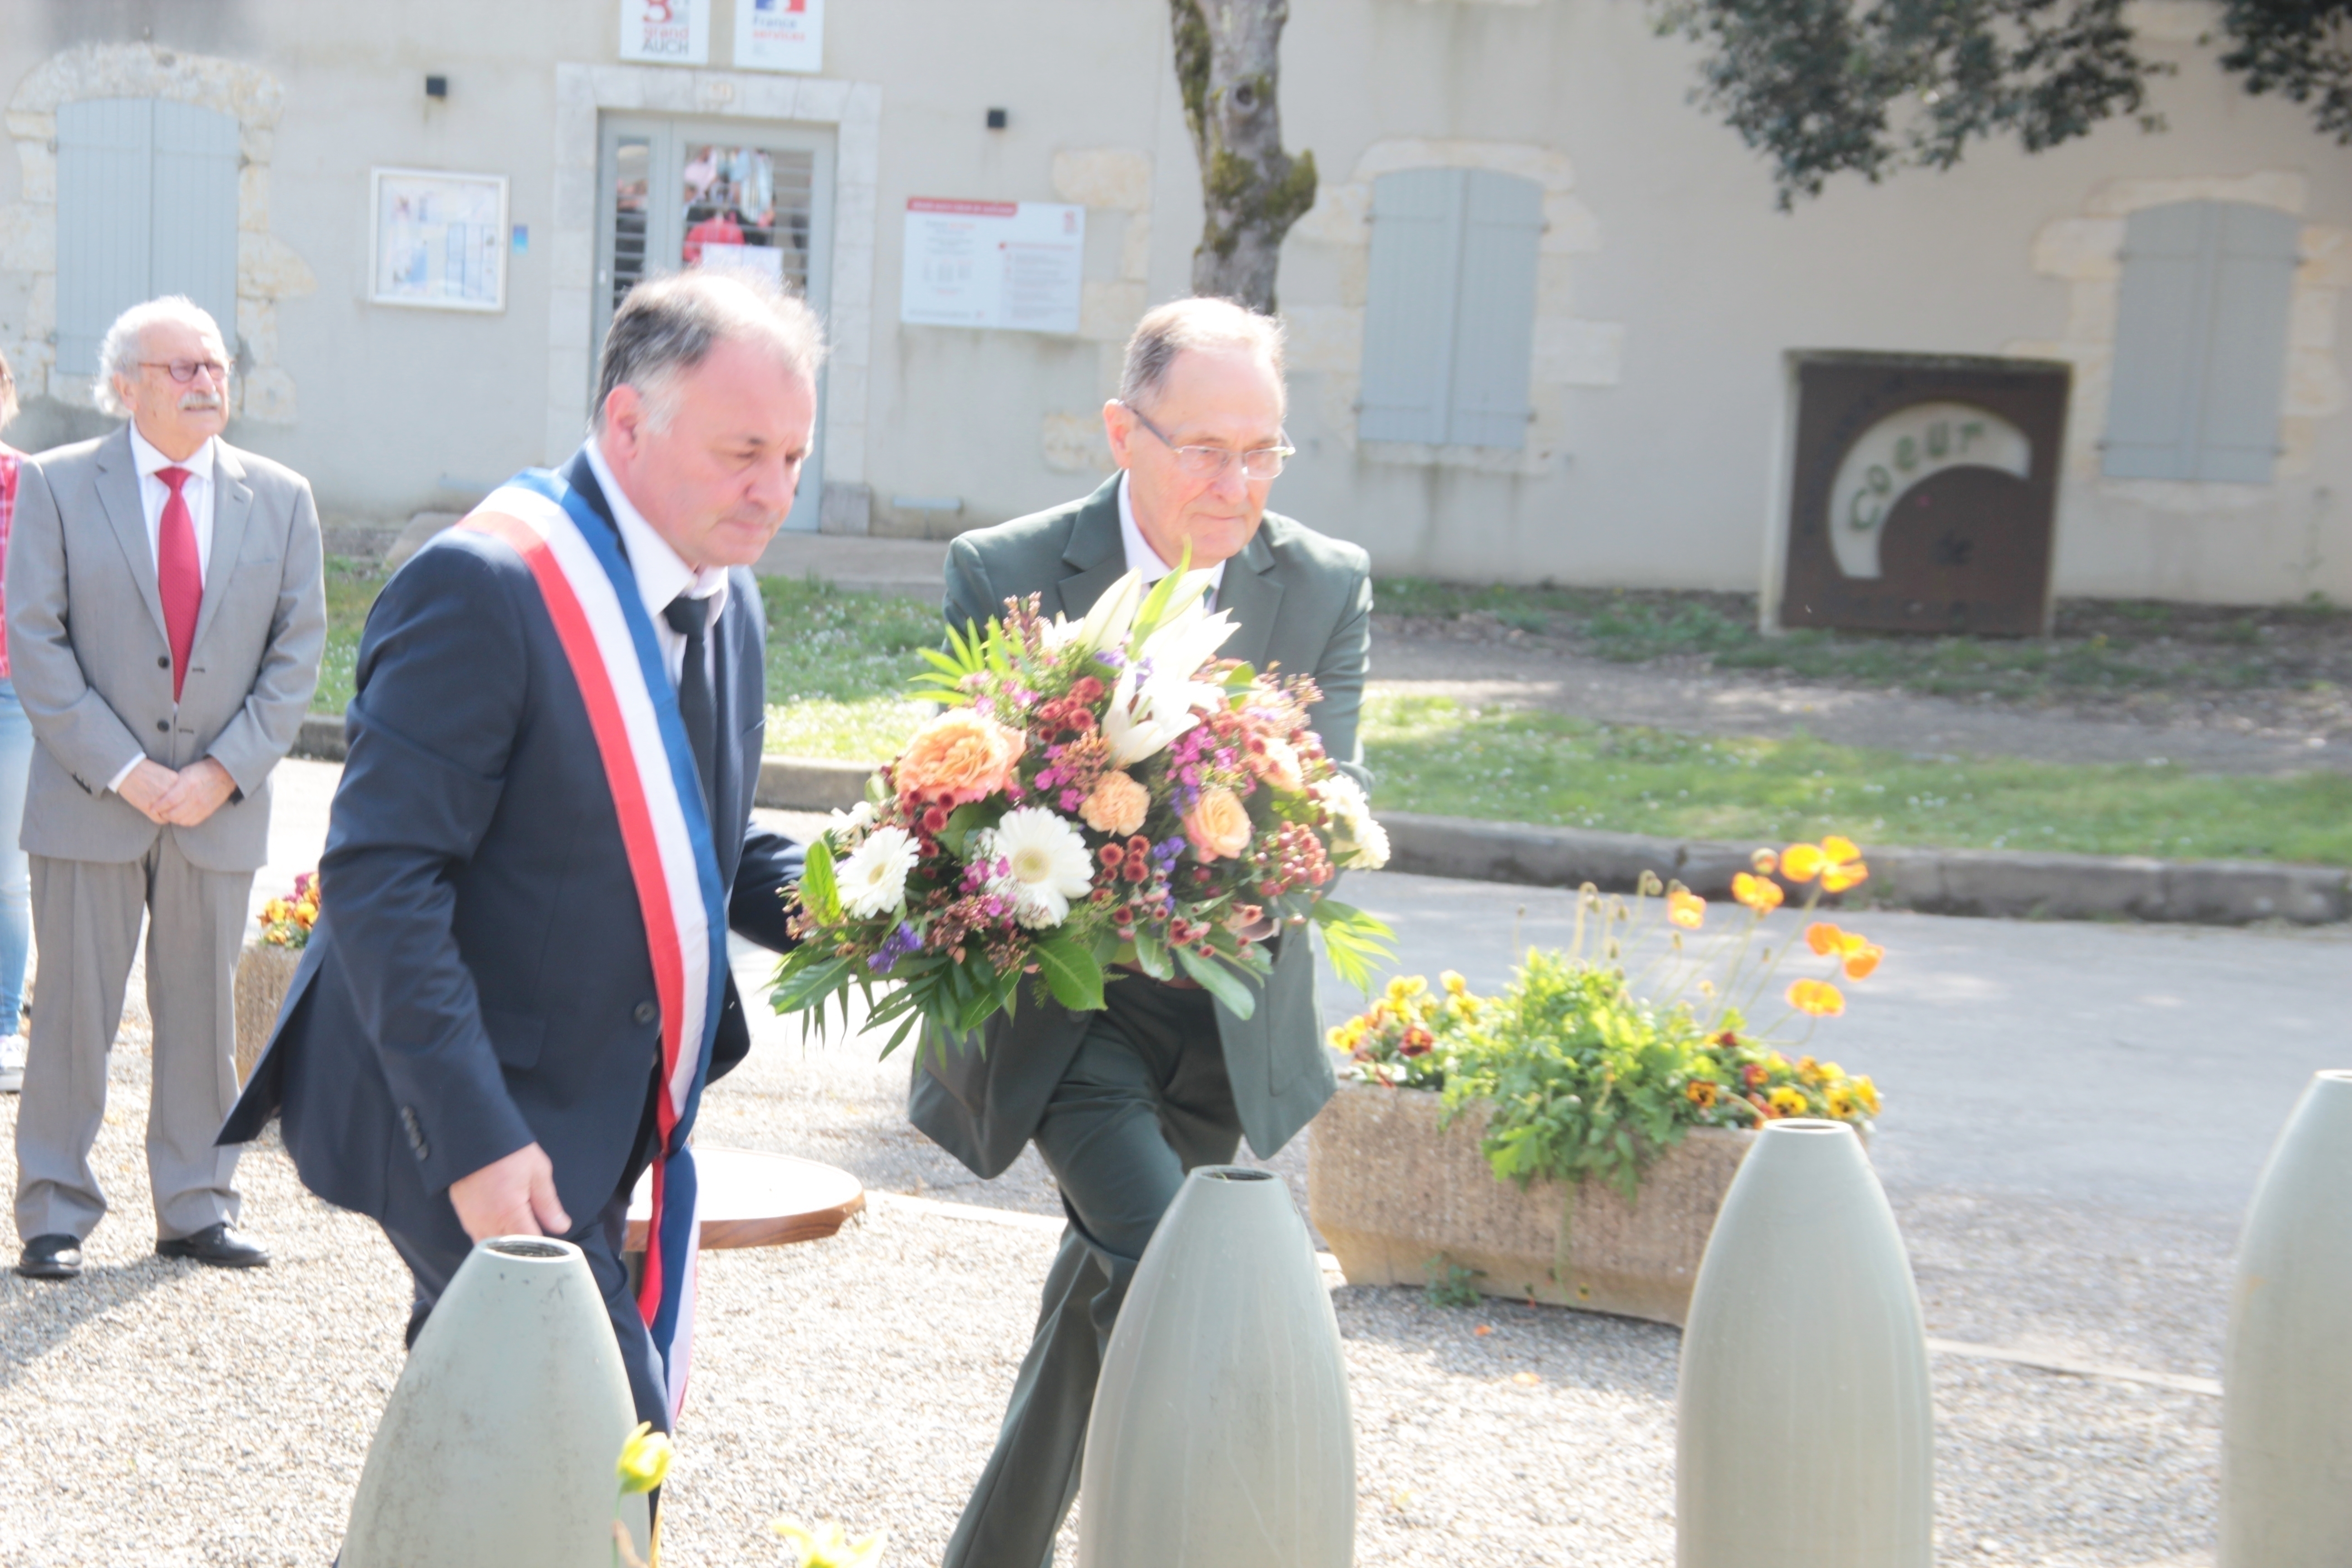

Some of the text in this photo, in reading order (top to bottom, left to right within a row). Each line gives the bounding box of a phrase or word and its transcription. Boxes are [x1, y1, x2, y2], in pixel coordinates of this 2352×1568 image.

[754, 15, 797, 28] France
[644, 26, 689, 41] grand
[753, 29, 805, 41] services
[642, 38, 689, 55] AUCH
